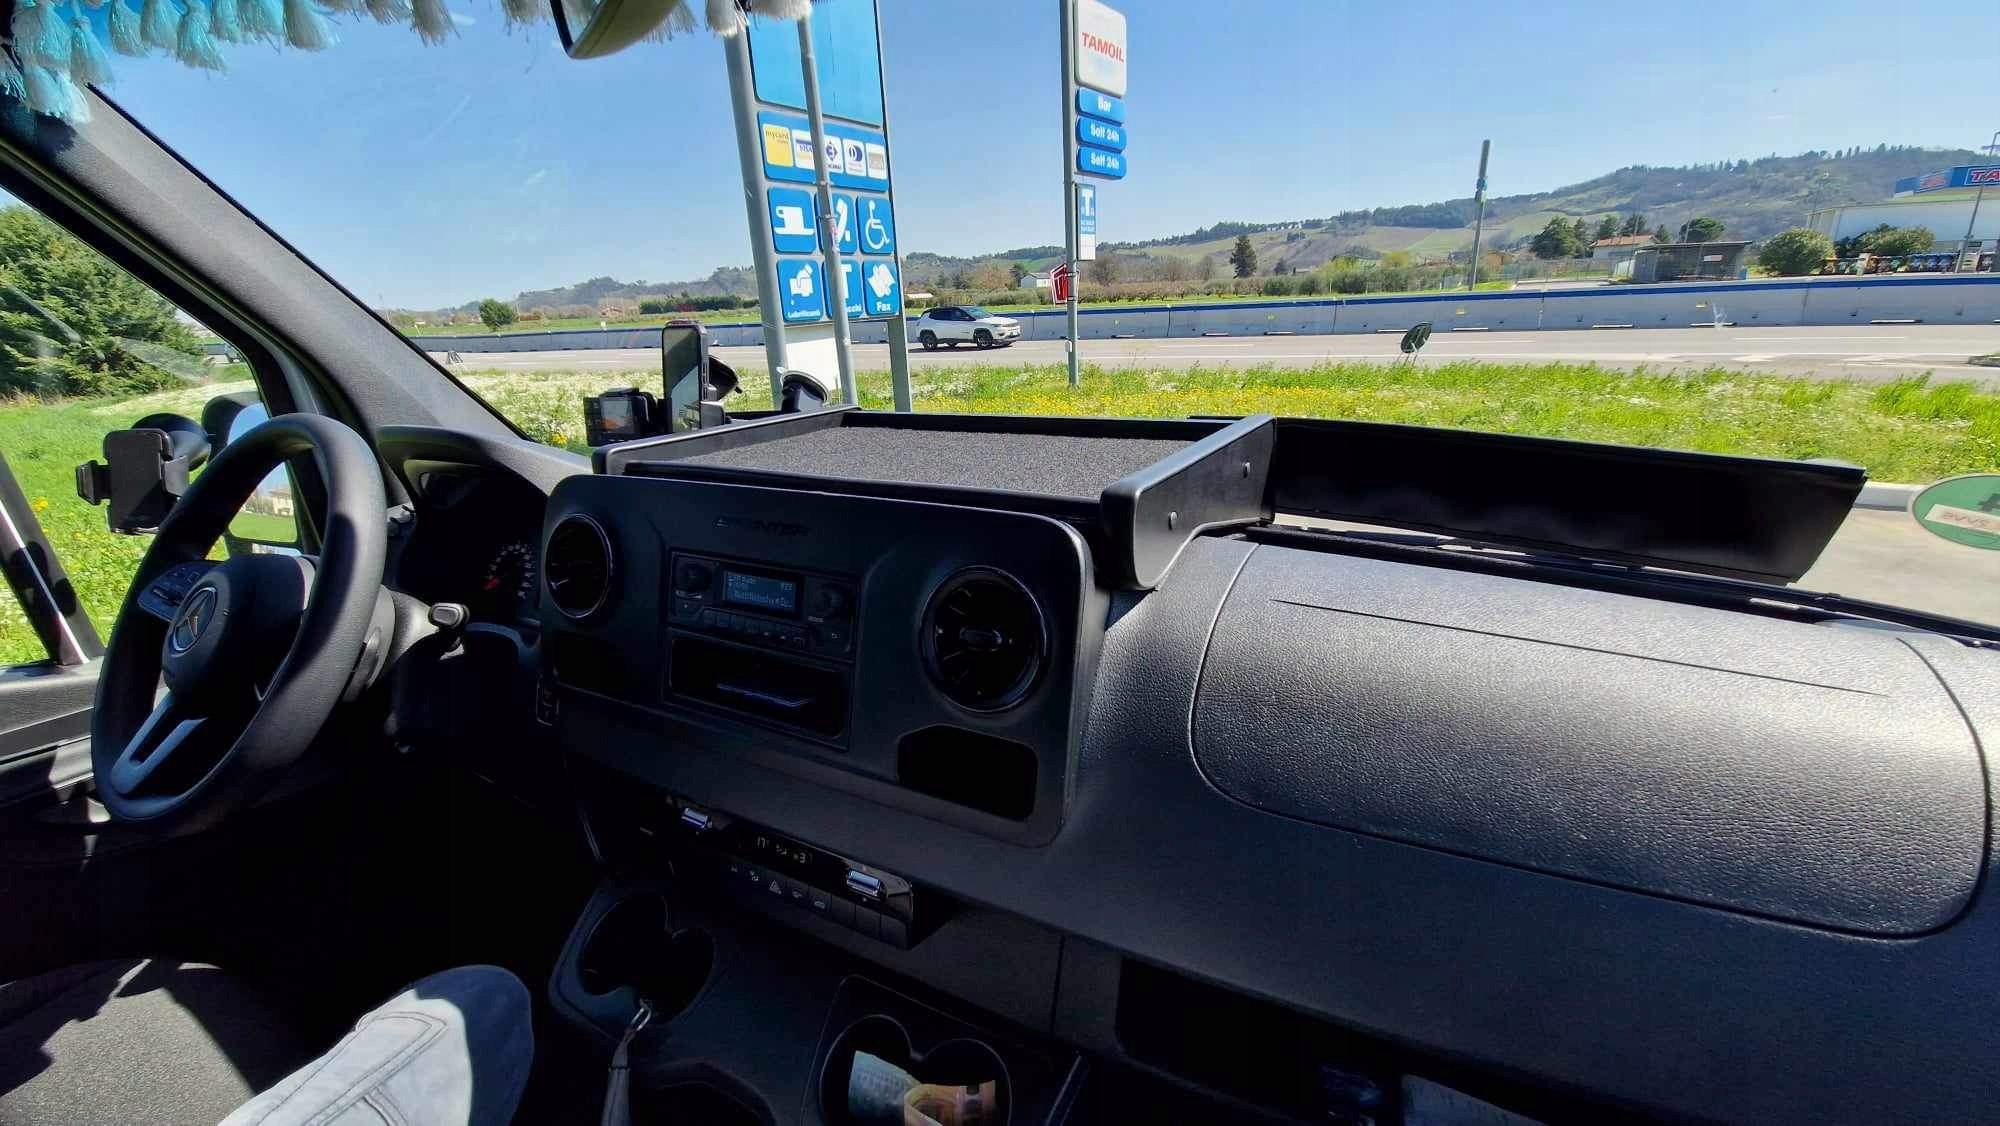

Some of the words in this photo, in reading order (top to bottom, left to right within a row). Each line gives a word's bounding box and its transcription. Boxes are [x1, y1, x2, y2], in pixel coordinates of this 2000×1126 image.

[1082, 32, 1124, 63] TAMOIL
[1098, 96, 1112, 113] Bar
[1090, 124, 1105, 139] Self
[1106, 127, 1120, 141] 24h
[1090, 153, 1105, 168] Self
[1106, 156, 1120, 171] 24h
[876, 302, 891, 312] Fax
